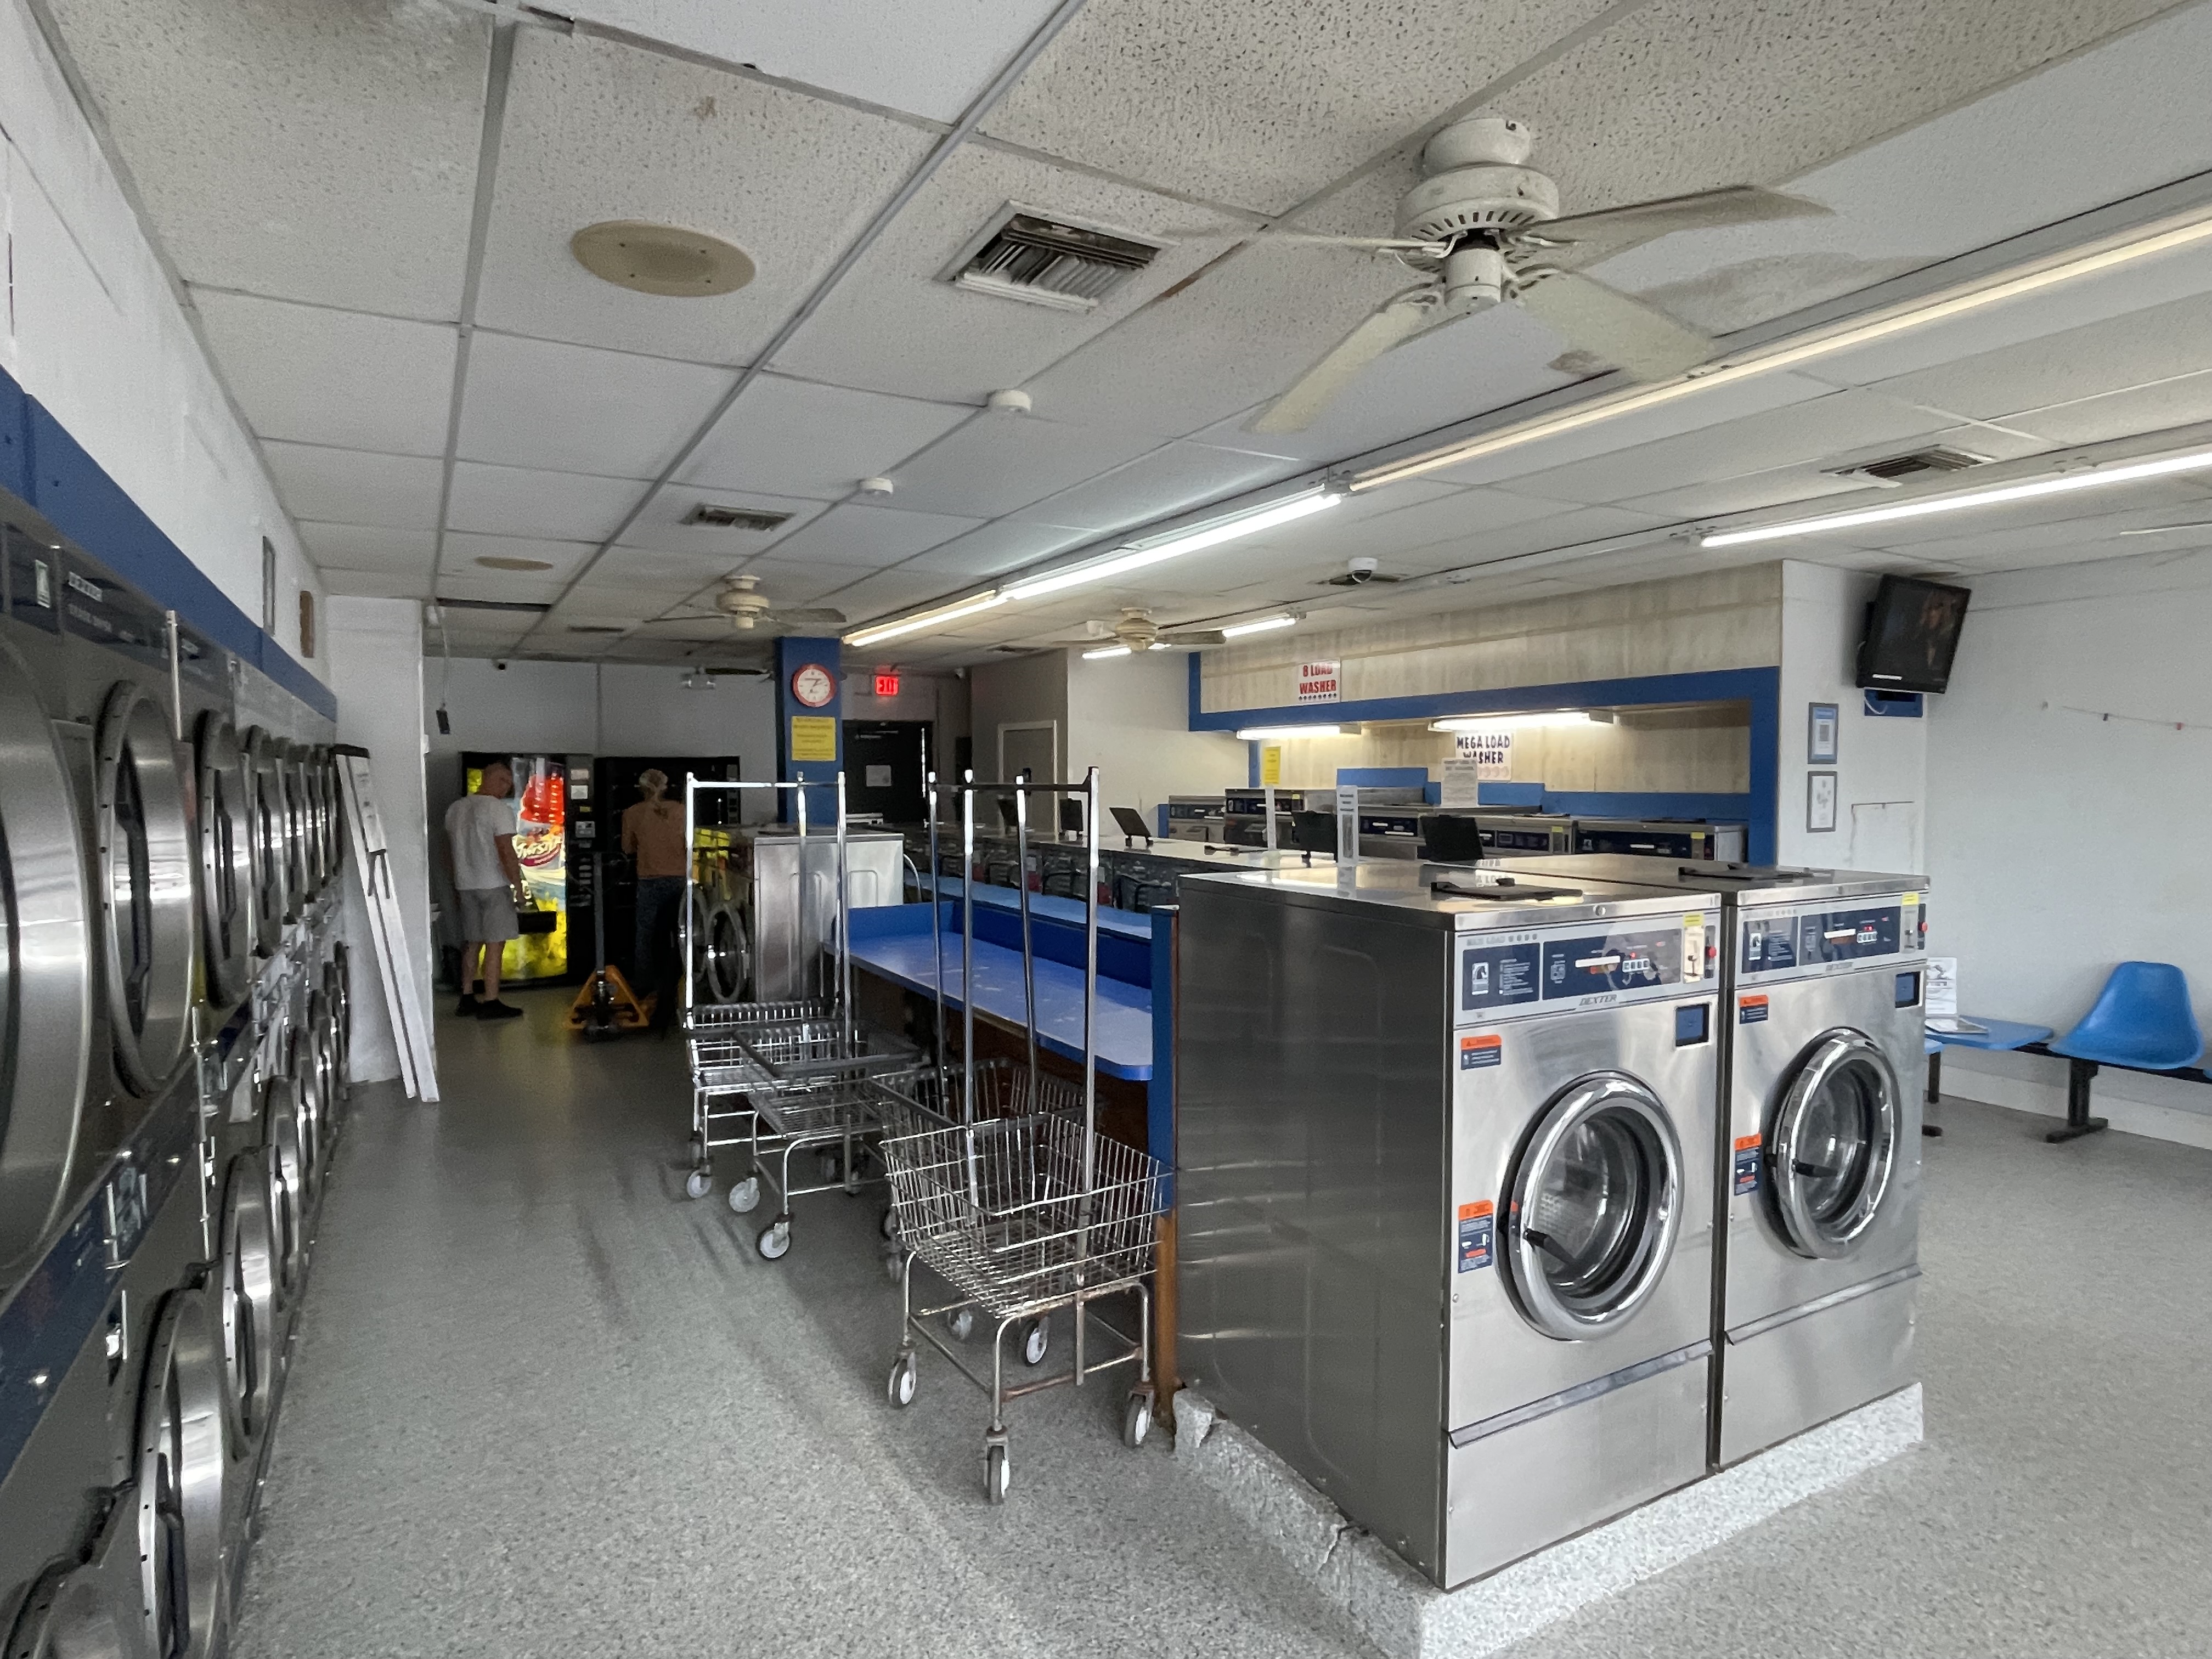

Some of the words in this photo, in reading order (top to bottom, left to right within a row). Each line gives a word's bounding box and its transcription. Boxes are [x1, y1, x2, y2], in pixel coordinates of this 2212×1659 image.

[1300, 680, 1336, 695] WASHER
[1457, 736, 1483, 749] MEGA
[1486, 735, 1510, 748] LOAD
[1579, 994, 1617, 1006] DEXTER
